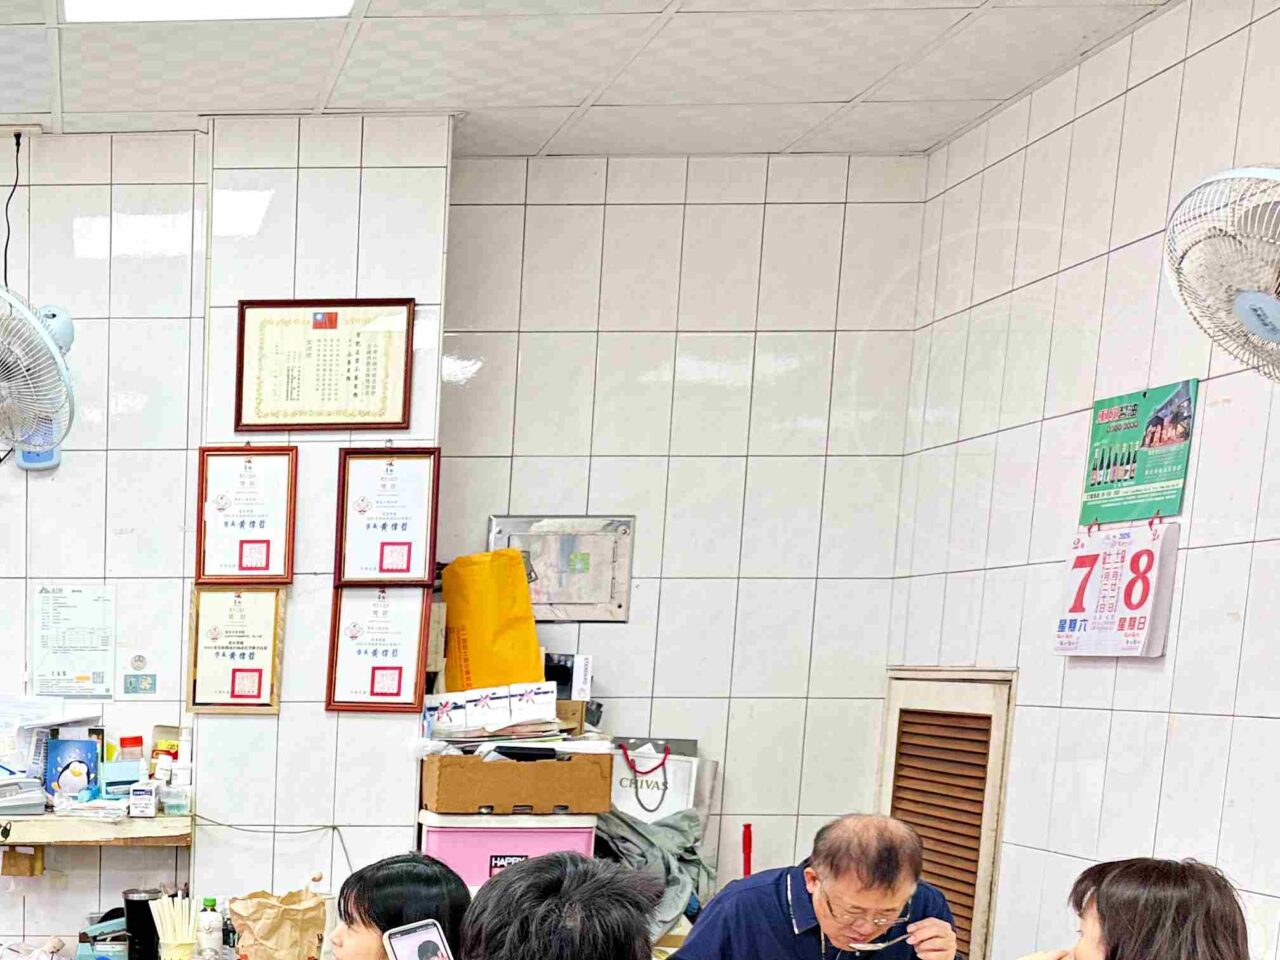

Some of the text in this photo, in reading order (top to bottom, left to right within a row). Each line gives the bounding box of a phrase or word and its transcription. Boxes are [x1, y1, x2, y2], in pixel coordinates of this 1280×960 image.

[1068, 553, 1100, 613] 7
[1123, 548, 1155, 611] 8
[619, 777, 668, 791] CHIVAS
